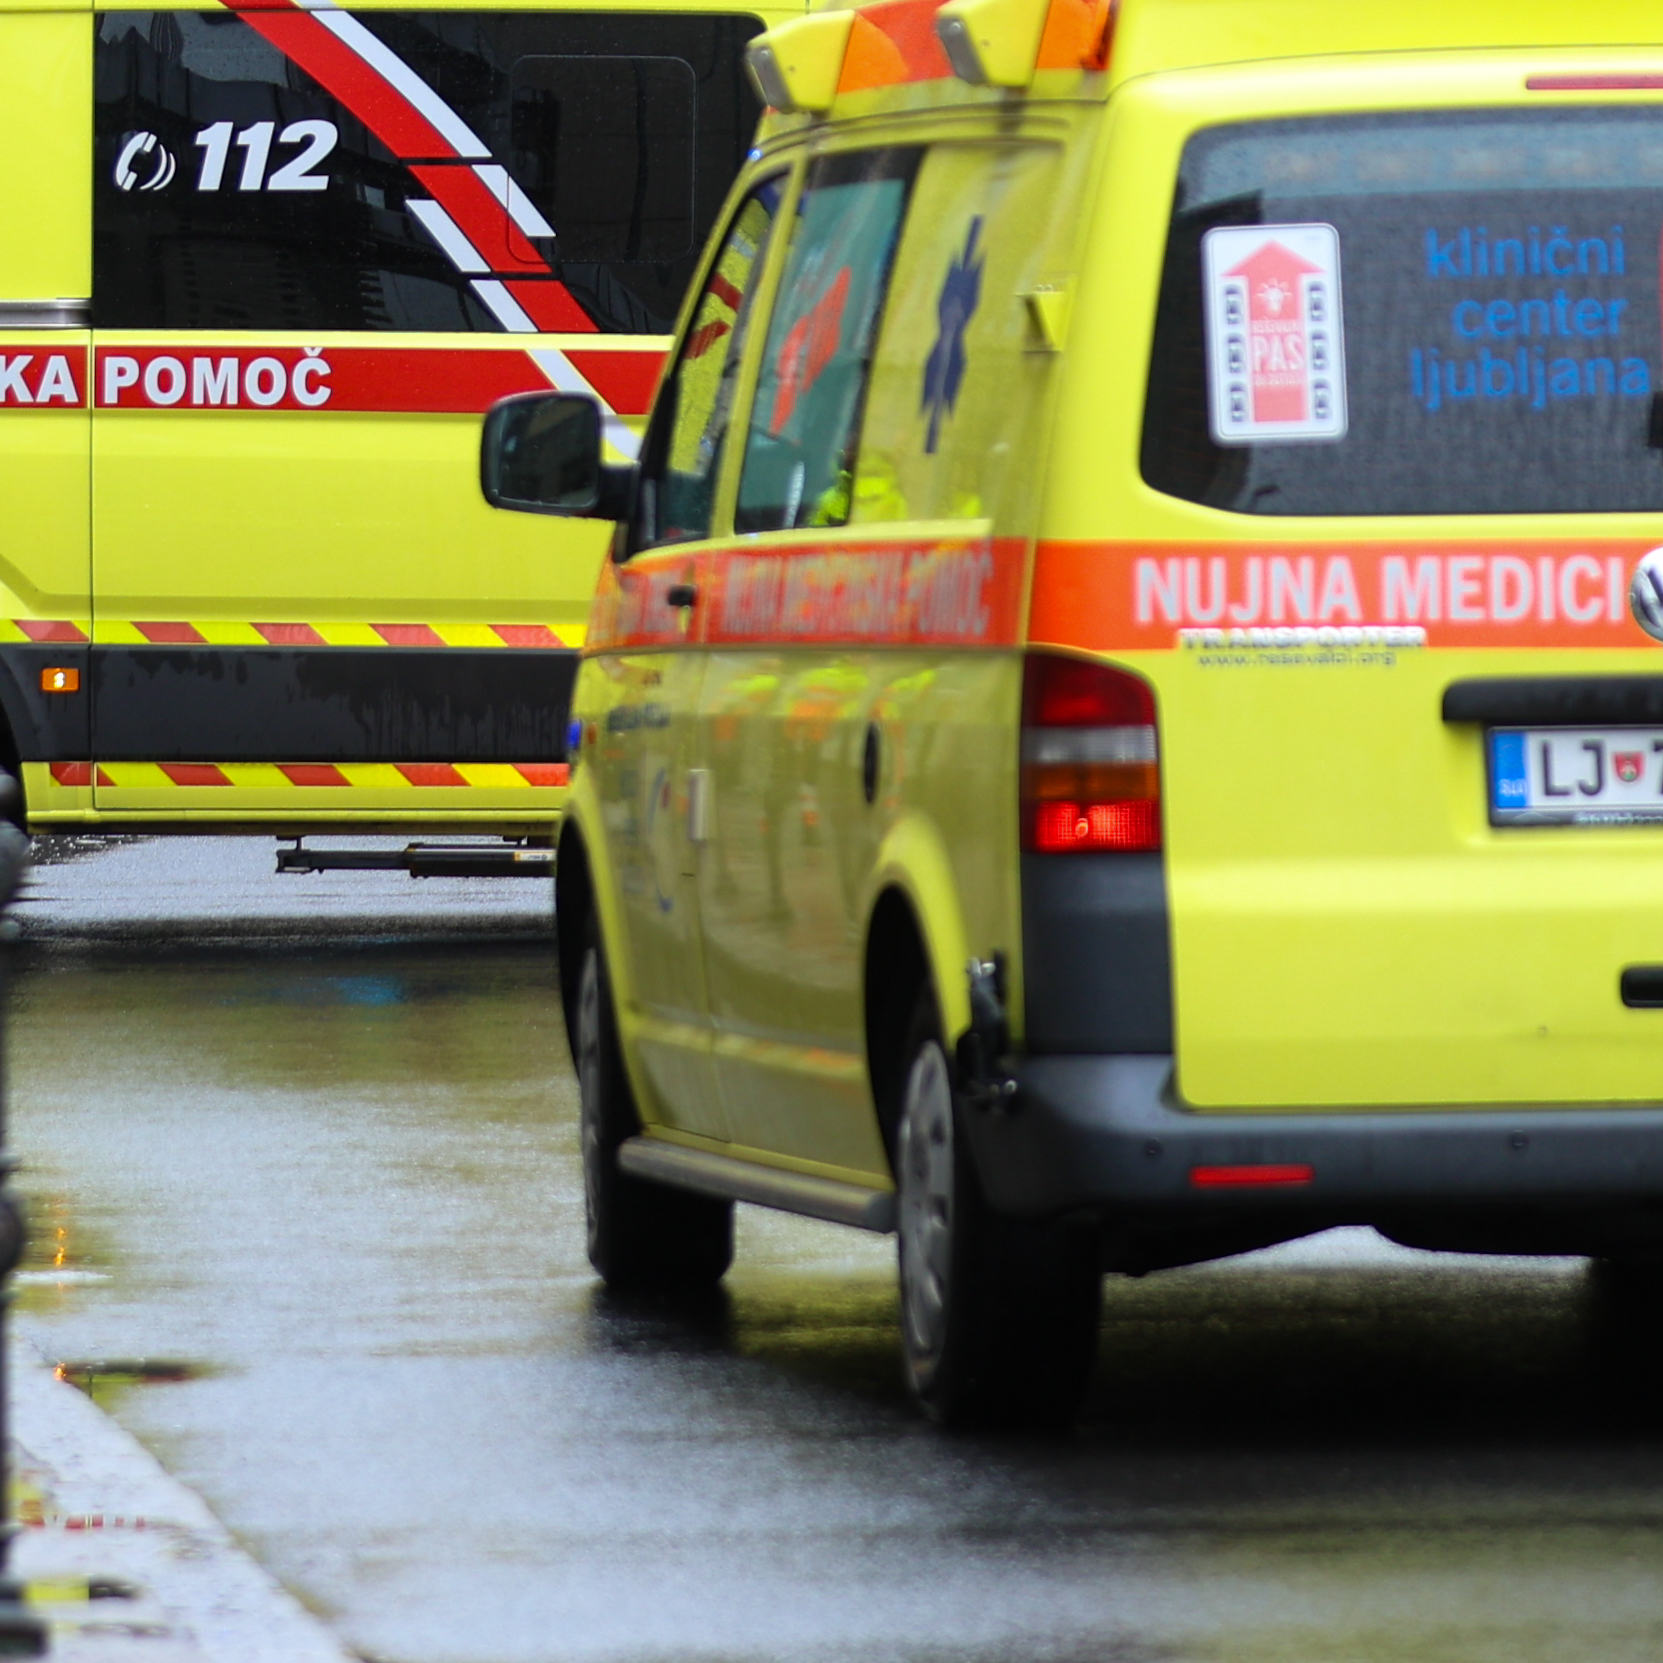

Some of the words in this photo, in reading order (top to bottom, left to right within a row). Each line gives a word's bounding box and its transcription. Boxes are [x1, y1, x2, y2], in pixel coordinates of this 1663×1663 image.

[195, 118, 338, 191] 112
[1425, 225, 1626, 277] klinični
[1451, 288, 1628, 337] center
[103, 346, 332, 407] POMOČ
[1253, 334, 1304, 372] PAS
[1410, 345, 1651, 411] ljubljana
[1138, 555, 1364, 624] NUJNA
[1178, 625, 1427, 649] TRANSPORTER
[1541, 737, 1605, 797] LJ
